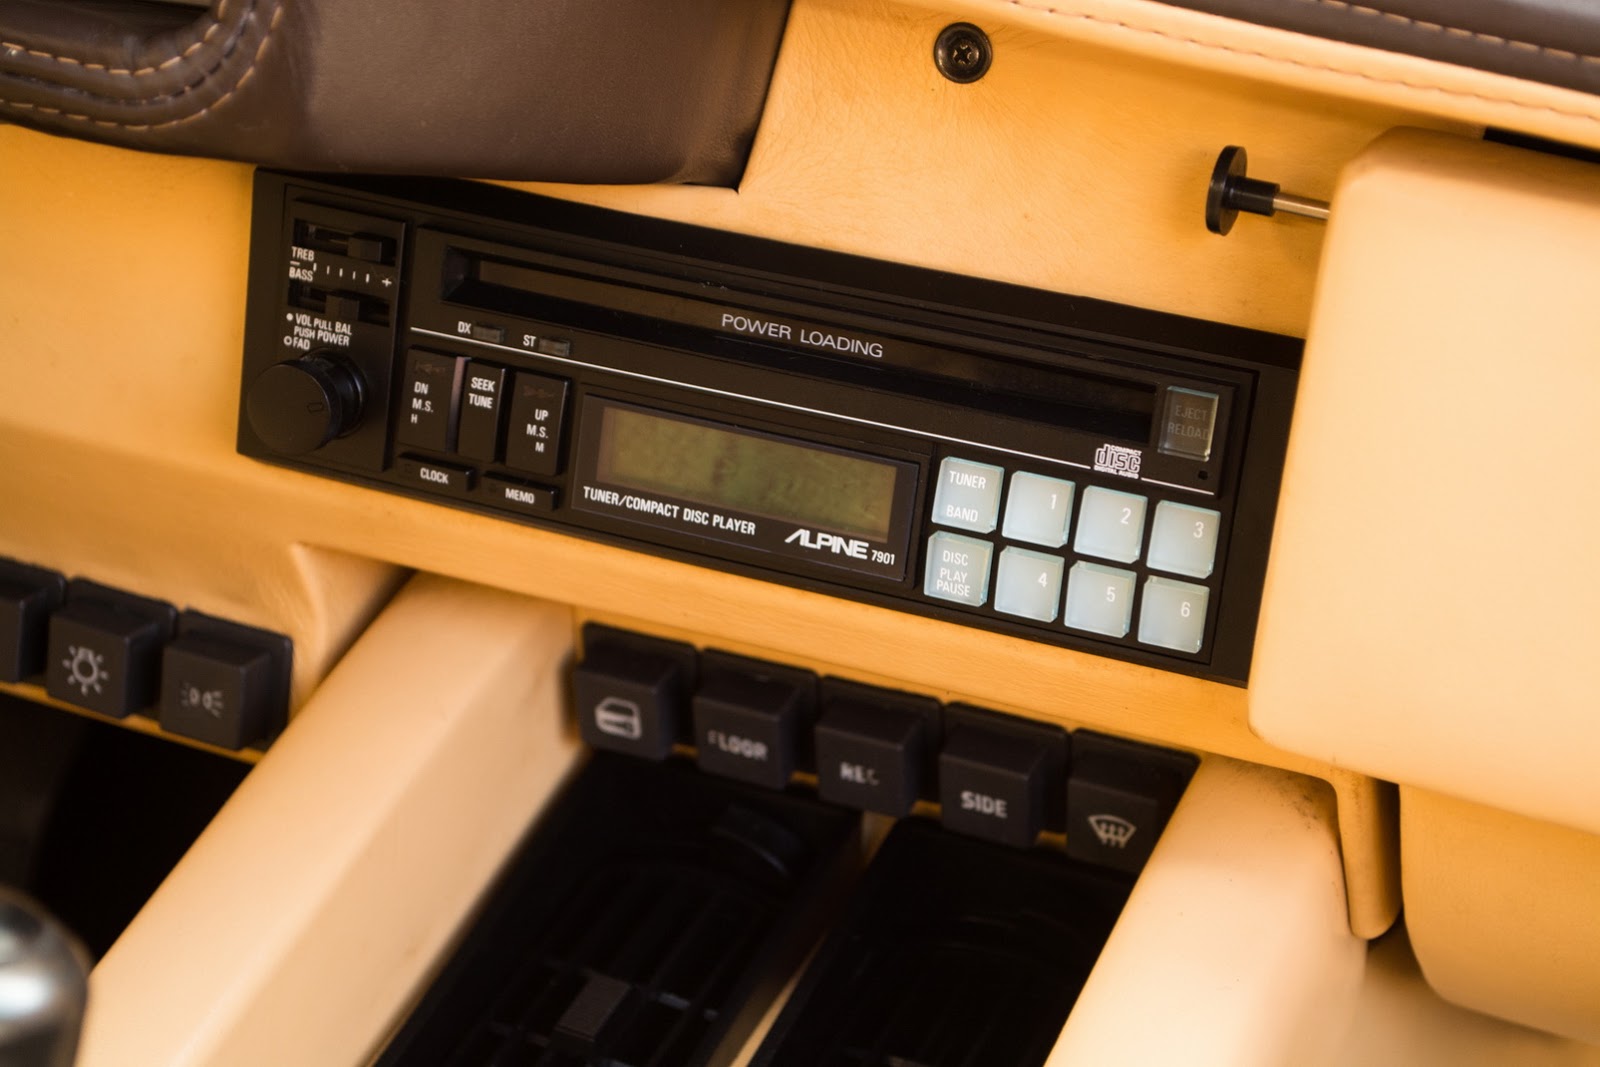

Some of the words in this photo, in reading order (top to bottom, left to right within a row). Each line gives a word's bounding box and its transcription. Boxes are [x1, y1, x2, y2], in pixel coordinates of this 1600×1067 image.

[292, 246, 314, 261] TREB
[289, 267, 313, 282] BASS
[296, 314, 312, 328] VOL
[314, 318, 332, 332] PULL
[335, 320, 352, 334] BAL
[458, 322, 471, 334] DX
[294, 326, 315, 339] PUSH
[317, 330, 350, 346] POWER
[523, 335, 535, 348] ST
[722, 314, 791, 339] POWER
[800, 329, 883, 358] LOADING
[293, 338, 310, 350] FAD
[415, 382, 428, 394] DN
[472, 378, 494, 392] SEEK
[412, 399, 433, 412] M.S.
[469, 394, 492, 409] TUNE
[411, 414, 418, 424] H
[535, 409, 548, 420] UP
[1175, 405, 1207, 422] EJECT
[527, 424, 548, 438] M.S.
[536, 442, 543, 452] M
[420, 468, 448, 484] CLOCK
[950, 471, 985, 489] TUNER
[506, 488, 534, 504] MEMO
[1050, 494, 1056, 509] 1
[584, 486, 678, 519] TUNER/COMPACT
[683, 509, 709, 525] DISC
[712, 515, 755, 535] PLAYER
[946, 506, 978, 522] BAND
[1121, 508, 1131, 524] 2
[1193, 522, 1203, 538] 3
[785, 529, 869, 559] ALPINE
[872, 550, 894, 565] 7901
[942, 550, 968, 565] DISC
[940, 569, 967, 583] PLAY
[1038, 573, 1047, 587] 4
[937, 580, 969, 597] PAUSE
[1107, 588, 1116, 602] 5
[1181, 602, 1190, 617] 6
[961, 790, 1008, 819] SIDE
